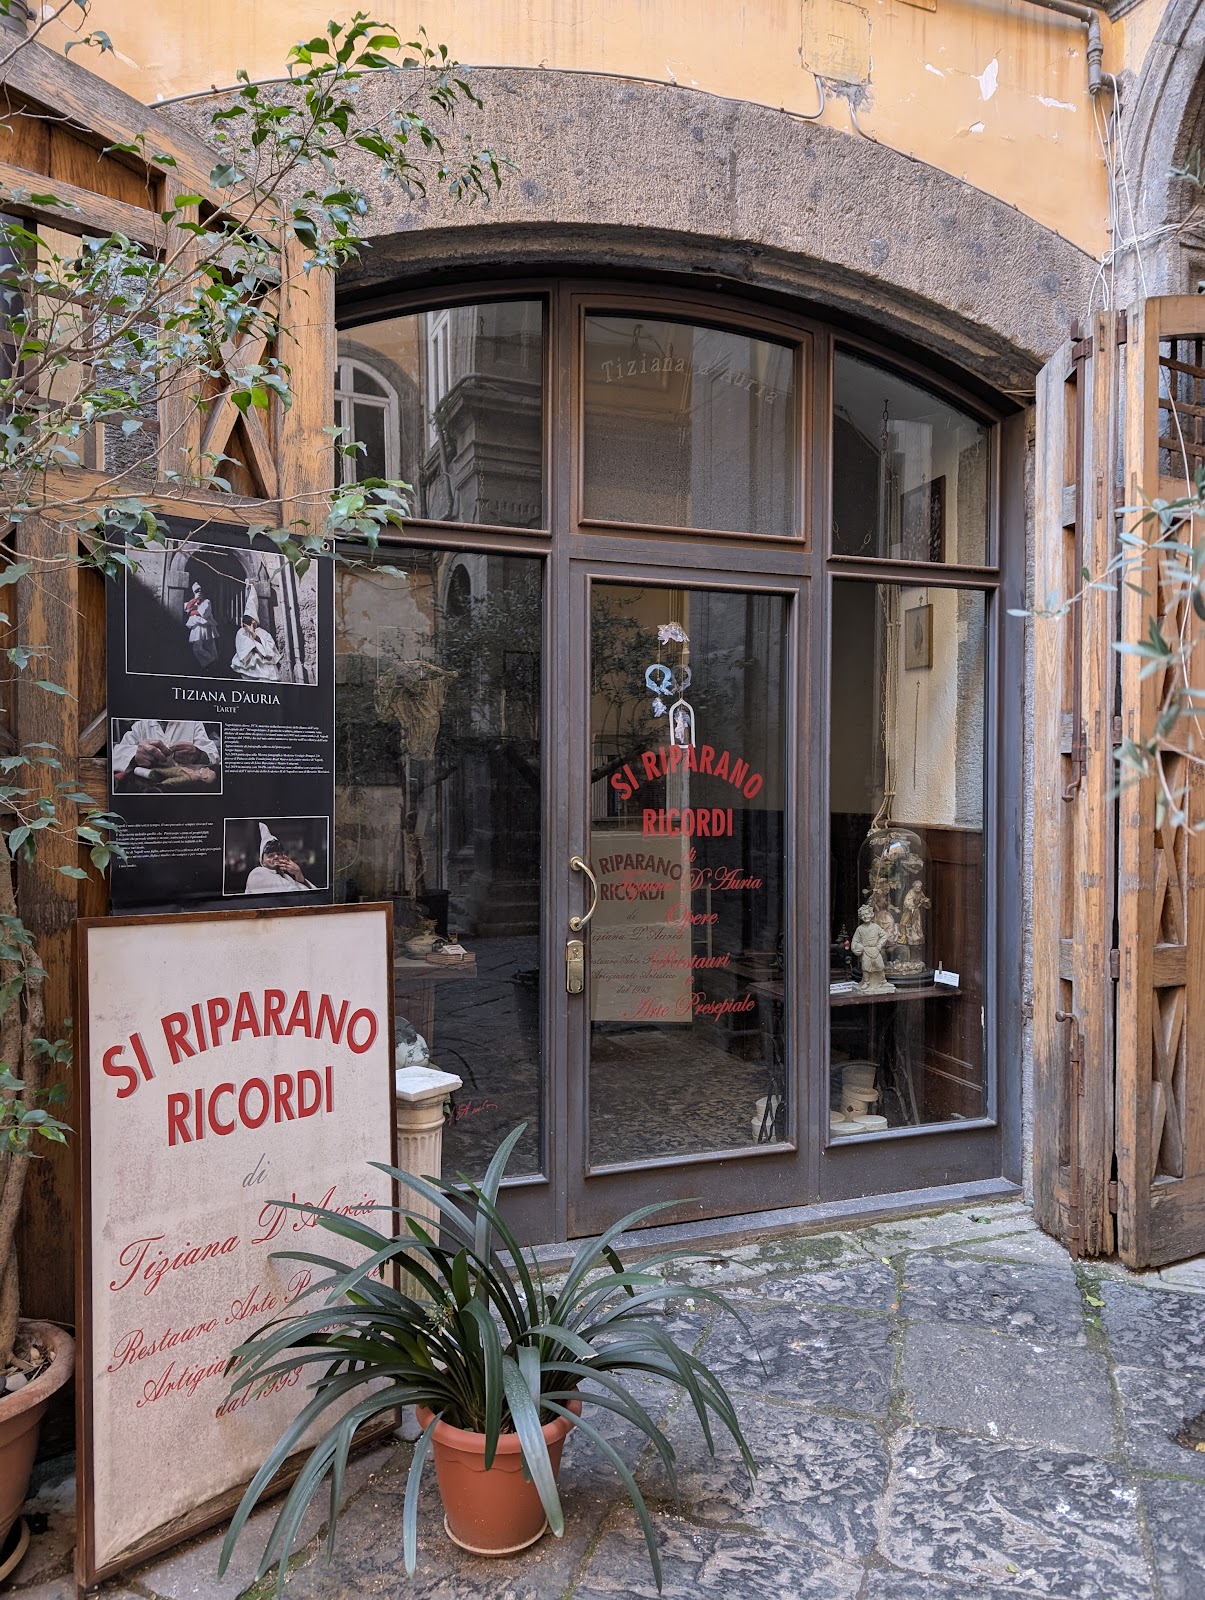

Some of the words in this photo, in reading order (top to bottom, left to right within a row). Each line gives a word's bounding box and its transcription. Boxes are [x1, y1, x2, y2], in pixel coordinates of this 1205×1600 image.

[601, 353, 686, 384] Tiziana
[171, 687, 227, 702] TIZIANA
[231, 690, 281, 705] D'AURIA
[610, 763, 641, 801] SI
[640, 743, 764, 800] RIPARANO
[642, 807, 733, 837] RICORDI
[598, 852, 683, 881] RIPARANO
[682, 846, 697, 863] di
[600, 883, 665, 901] RICORDI
[681, 865, 764, 892] D'Auria
[665, 902, 719, 936] Opere
[591, 928, 627, 945] iziana
[650, 945, 732, 972] Restauri
[684, 975, 695, 988] e
[623, 996, 669, 1021] Arte
[674, 991, 756, 1023] Presepiale
[102, 1032, 156, 1099] SI
[161, 989, 379, 1065] RIPARANO
[167, 1065, 335, 1147] RICORDI
[242, 1152, 271, 1189] di
[109, 1234, 241, 1296] Tiziana
[107, 1319, 220, 1373] Restauro
[224, 1284, 278, 1326] Arte
